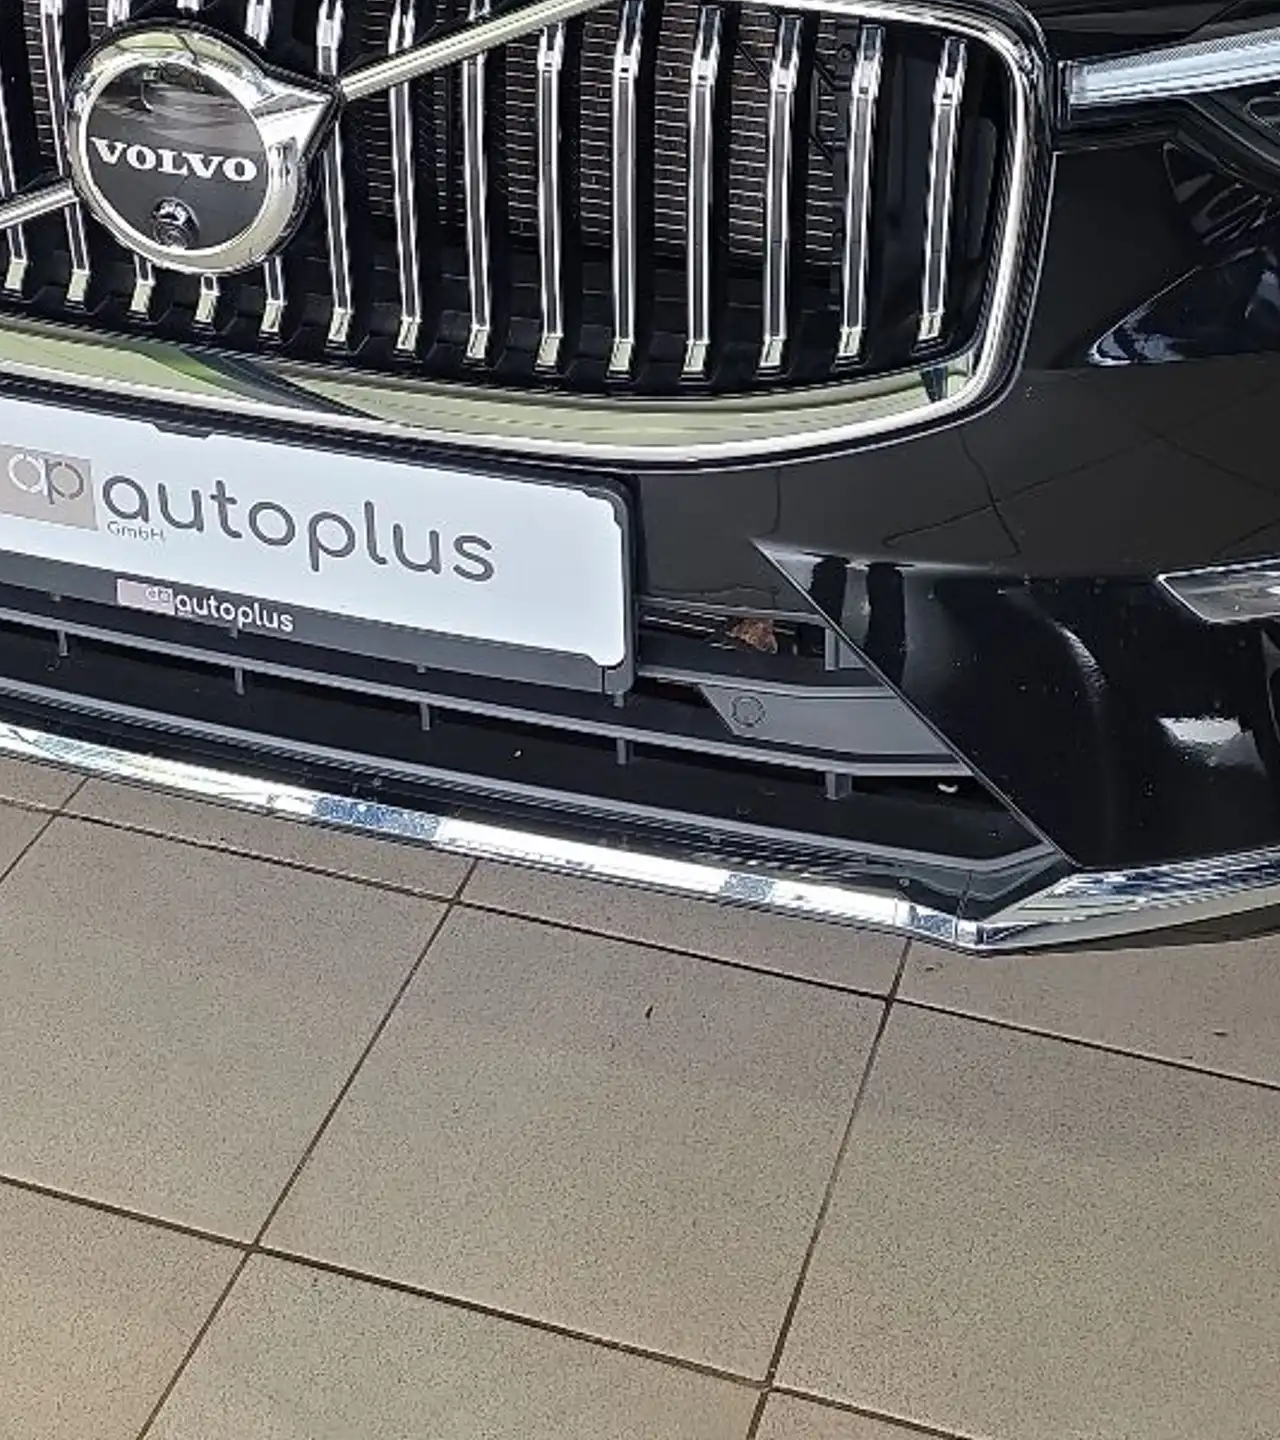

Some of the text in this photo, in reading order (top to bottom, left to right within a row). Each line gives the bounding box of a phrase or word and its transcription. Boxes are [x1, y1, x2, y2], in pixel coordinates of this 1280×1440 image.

[90, 136, 258, 182] VOLVO
[102, 474, 497, 582] autoplus
[107, 520, 166, 541] GmbH
[175, 591, 295, 632] autoplus
